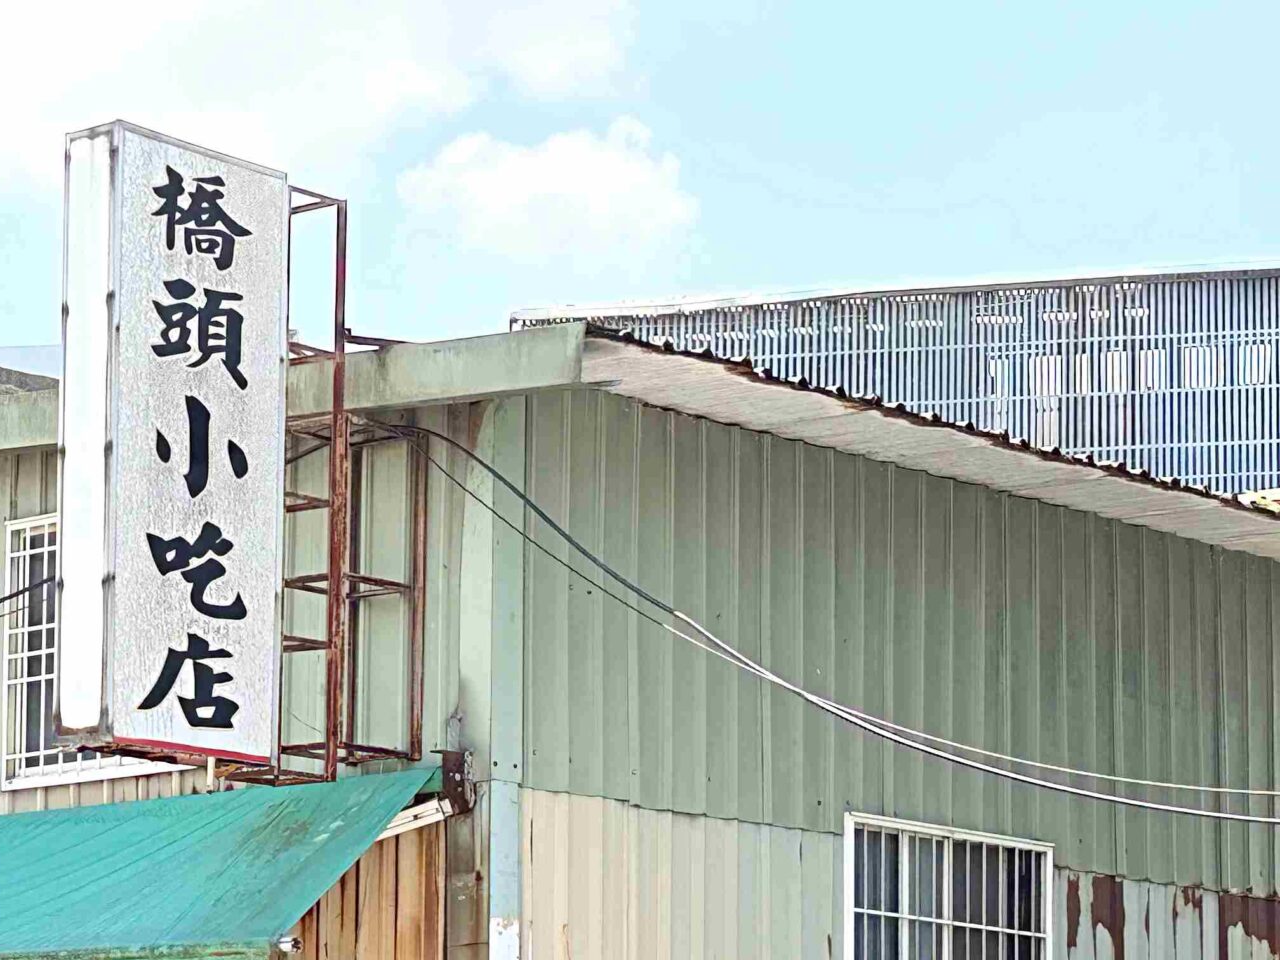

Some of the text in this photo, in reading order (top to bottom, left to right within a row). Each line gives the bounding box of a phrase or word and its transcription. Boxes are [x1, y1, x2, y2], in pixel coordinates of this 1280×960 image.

[136, 164, 254, 732] 橋頭小吃店
